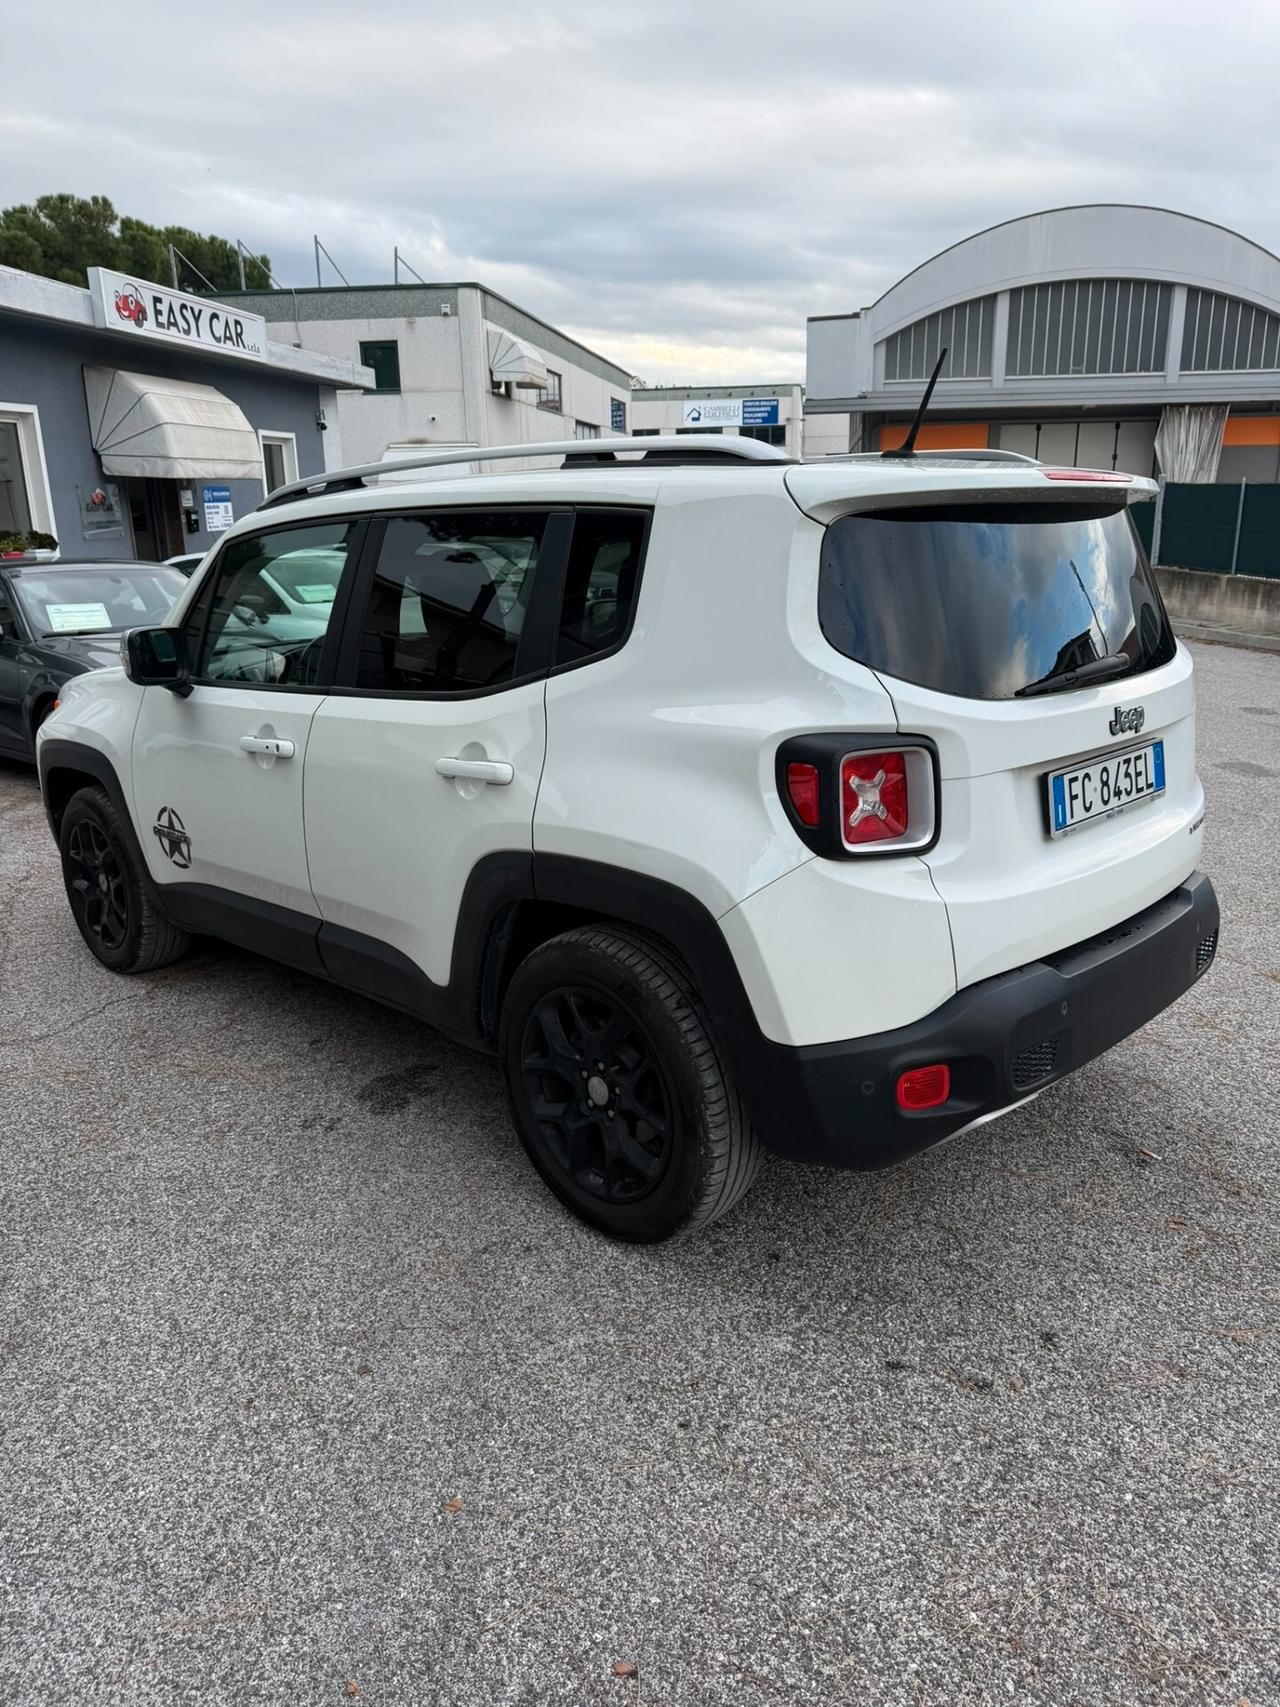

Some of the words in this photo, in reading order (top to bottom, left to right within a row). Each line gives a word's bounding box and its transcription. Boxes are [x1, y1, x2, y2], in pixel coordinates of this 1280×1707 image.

[152, 295, 202, 338] EASY
[208, 312, 246, 350] CAR
[1109, 705, 1145, 736] Jeep
[1068, 772, 1094, 820] FC
[1099, 751, 1155, 807] 843EL
